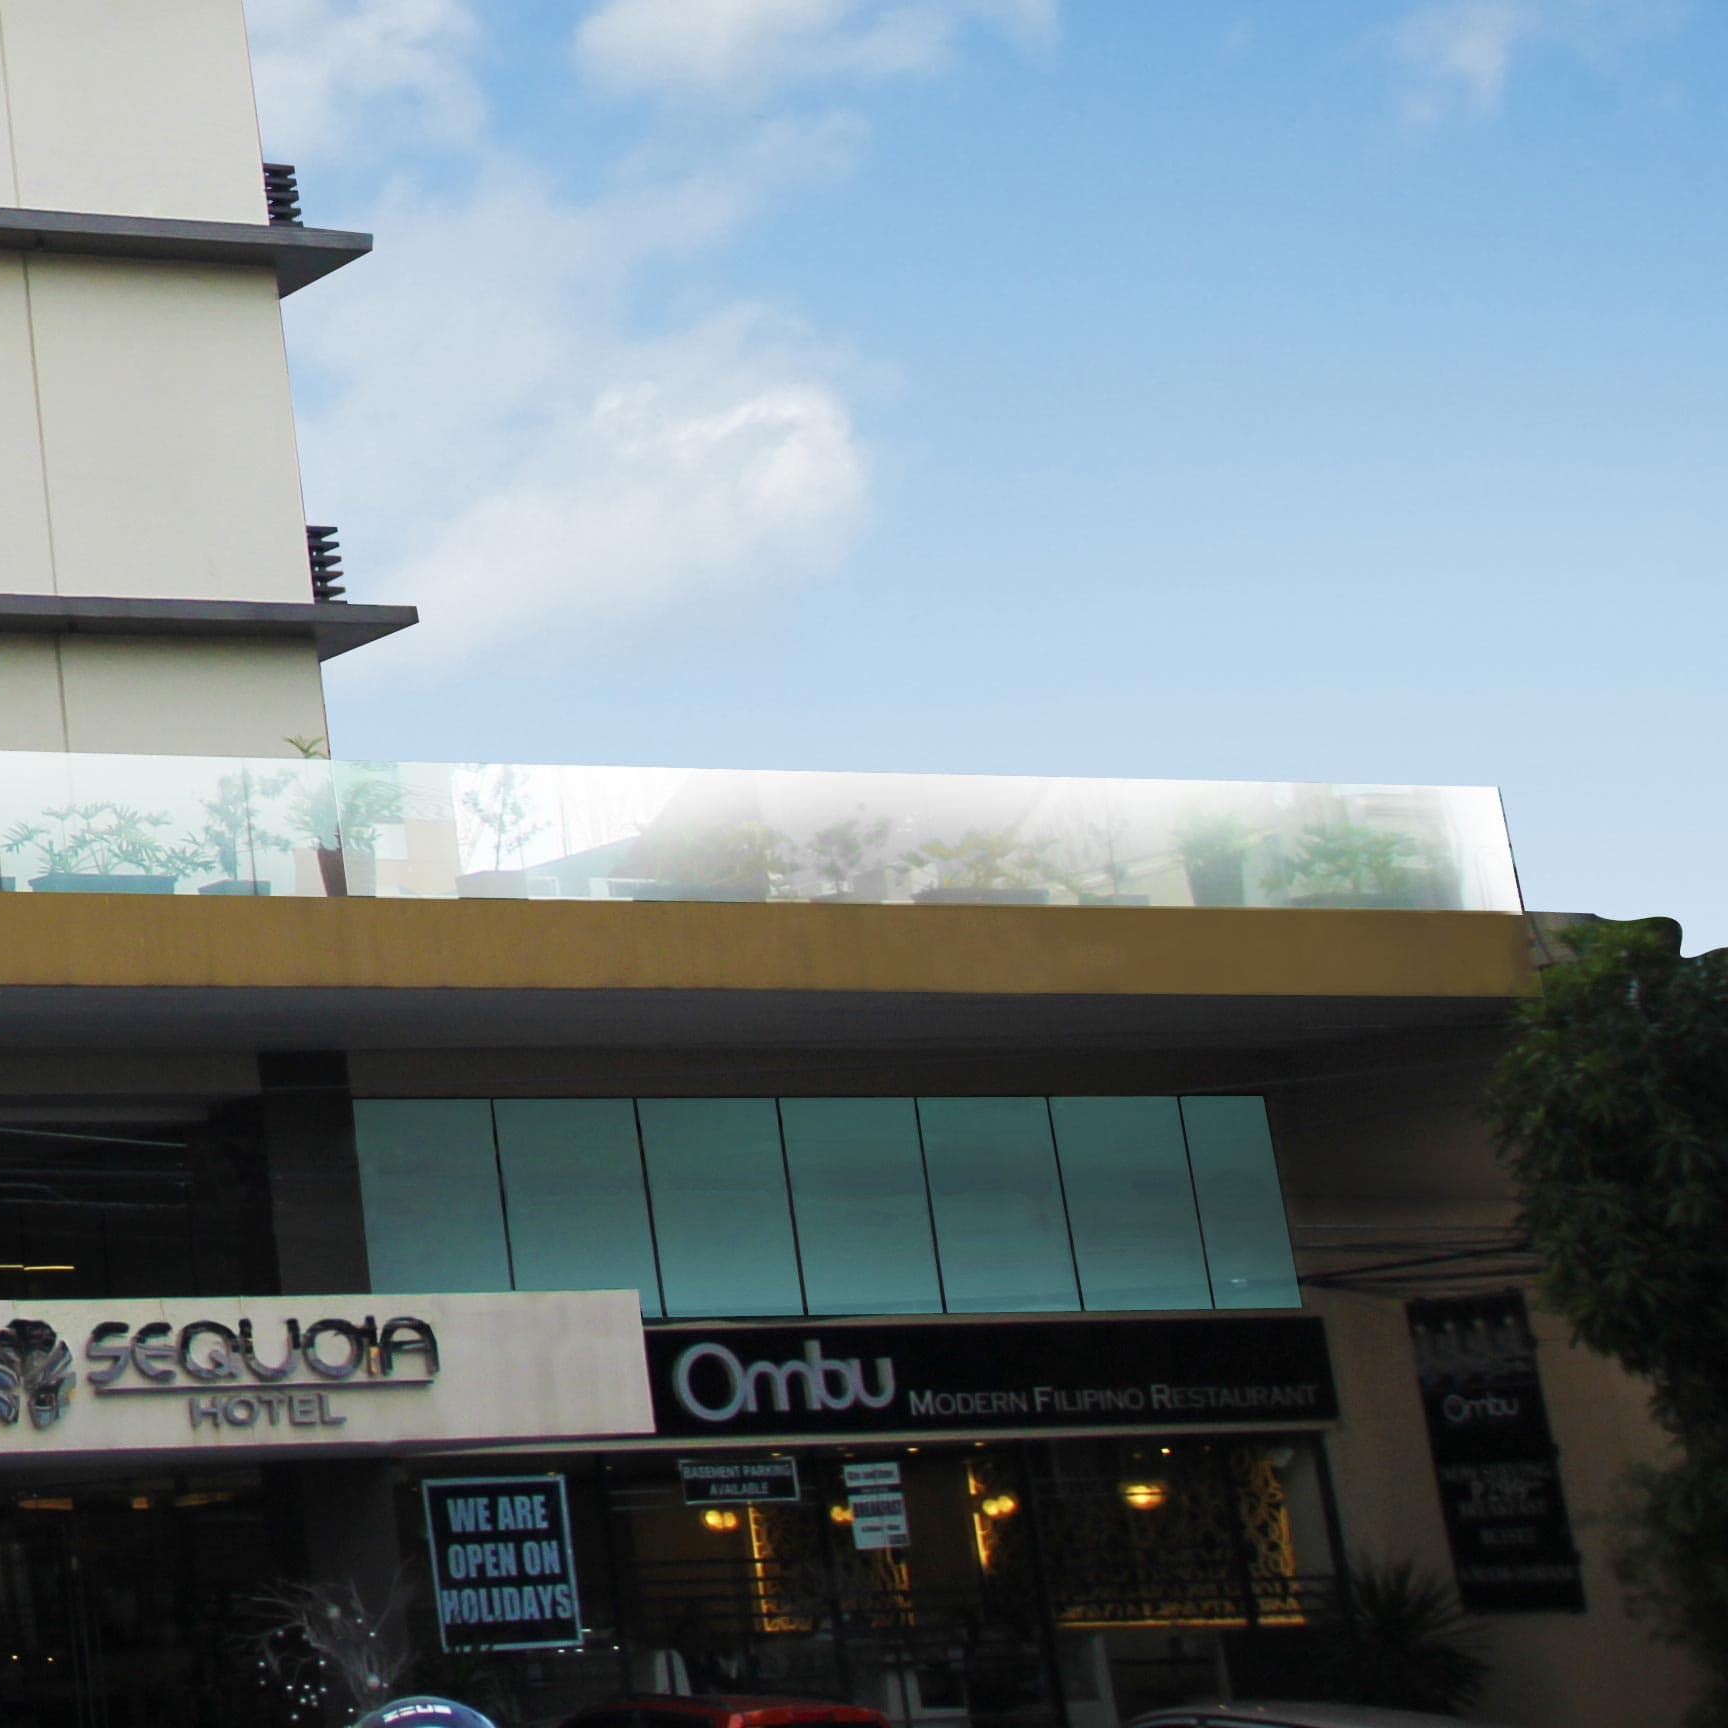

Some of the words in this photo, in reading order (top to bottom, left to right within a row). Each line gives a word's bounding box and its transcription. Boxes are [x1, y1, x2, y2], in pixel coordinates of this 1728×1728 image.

[85, 1315, 440, 1384] SEQUOIA
[671, 1338, 897, 1422] Ombu
[189, 1393, 347, 1429] HOTEL
[908, 1389, 1028, 1417] MODERN
[1033, 1385, 1144, 1413] FILIPINO
[1150, 1382, 1318, 1410] RESTAURANT
[1442, 1392, 1521, 1424] Ombu
[682, 1464, 740, 1479] BASEMENT
[742, 1463, 793, 1477] PARKING
[709, 1480, 770, 1496] AVAILABLE
[446, 1497, 493, 1533] WE
[497, 1495, 549, 1531] ARE
[447, 1542, 518, 1579] OPEN
[522, 1540, 562, 1576] ON
[441, 1583, 573, 1624] HOLIDAYS
